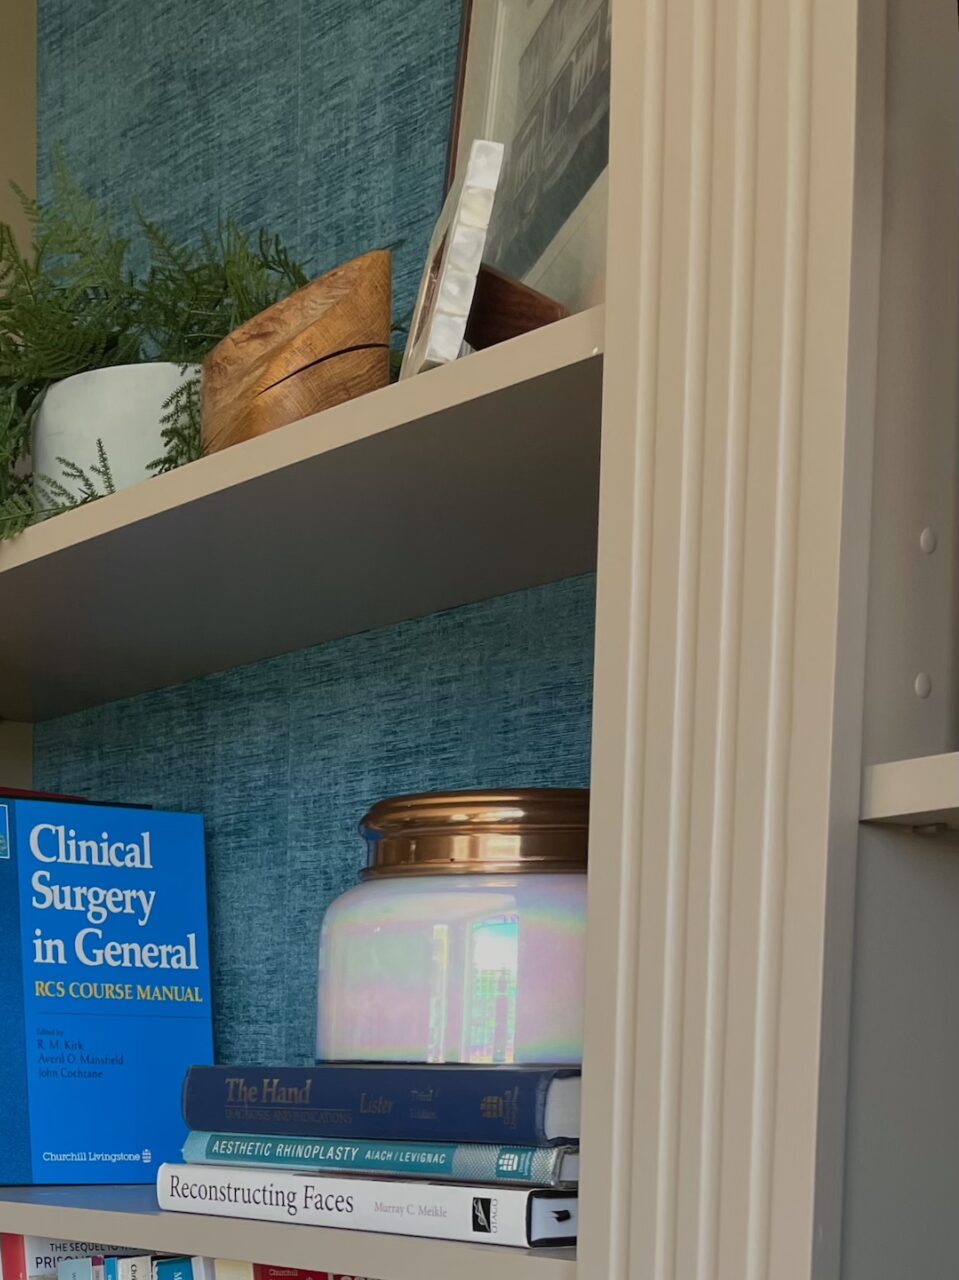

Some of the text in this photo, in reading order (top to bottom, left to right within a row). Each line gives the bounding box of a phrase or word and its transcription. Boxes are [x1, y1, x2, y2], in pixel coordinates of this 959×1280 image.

[28, 823, 154, 869] Clinical
[31, 870, 156, 927] Surgery
[32, 927, 200, 970] in General
[34, 980, 204, 1003] RCS COURSE MANUAL
[64, 1039, 84, 1050] Kirk
[39, 1053, 125, 1066] Averil Mansfield
[38, 1067, 104, 1080] John Cochrane
[224, 1077, 313, 1105] The Hand
[359, 1092, 395, 1115] Lister
[42, 1151, 141, 1163] Churchill Livingstone
[212, 1140, 272, 1156] AESTHETIC
[275, 1143, 360, 1162] RHINOPLASTY
[169, 1175, 448, 1219] Reconstructing Faces Murray C. Meikle
[491, 1197, 499, 1234] OTAGO
[49, 1243, 69, 1253] THE
[268, 1268, 299, 1277] Churchill
